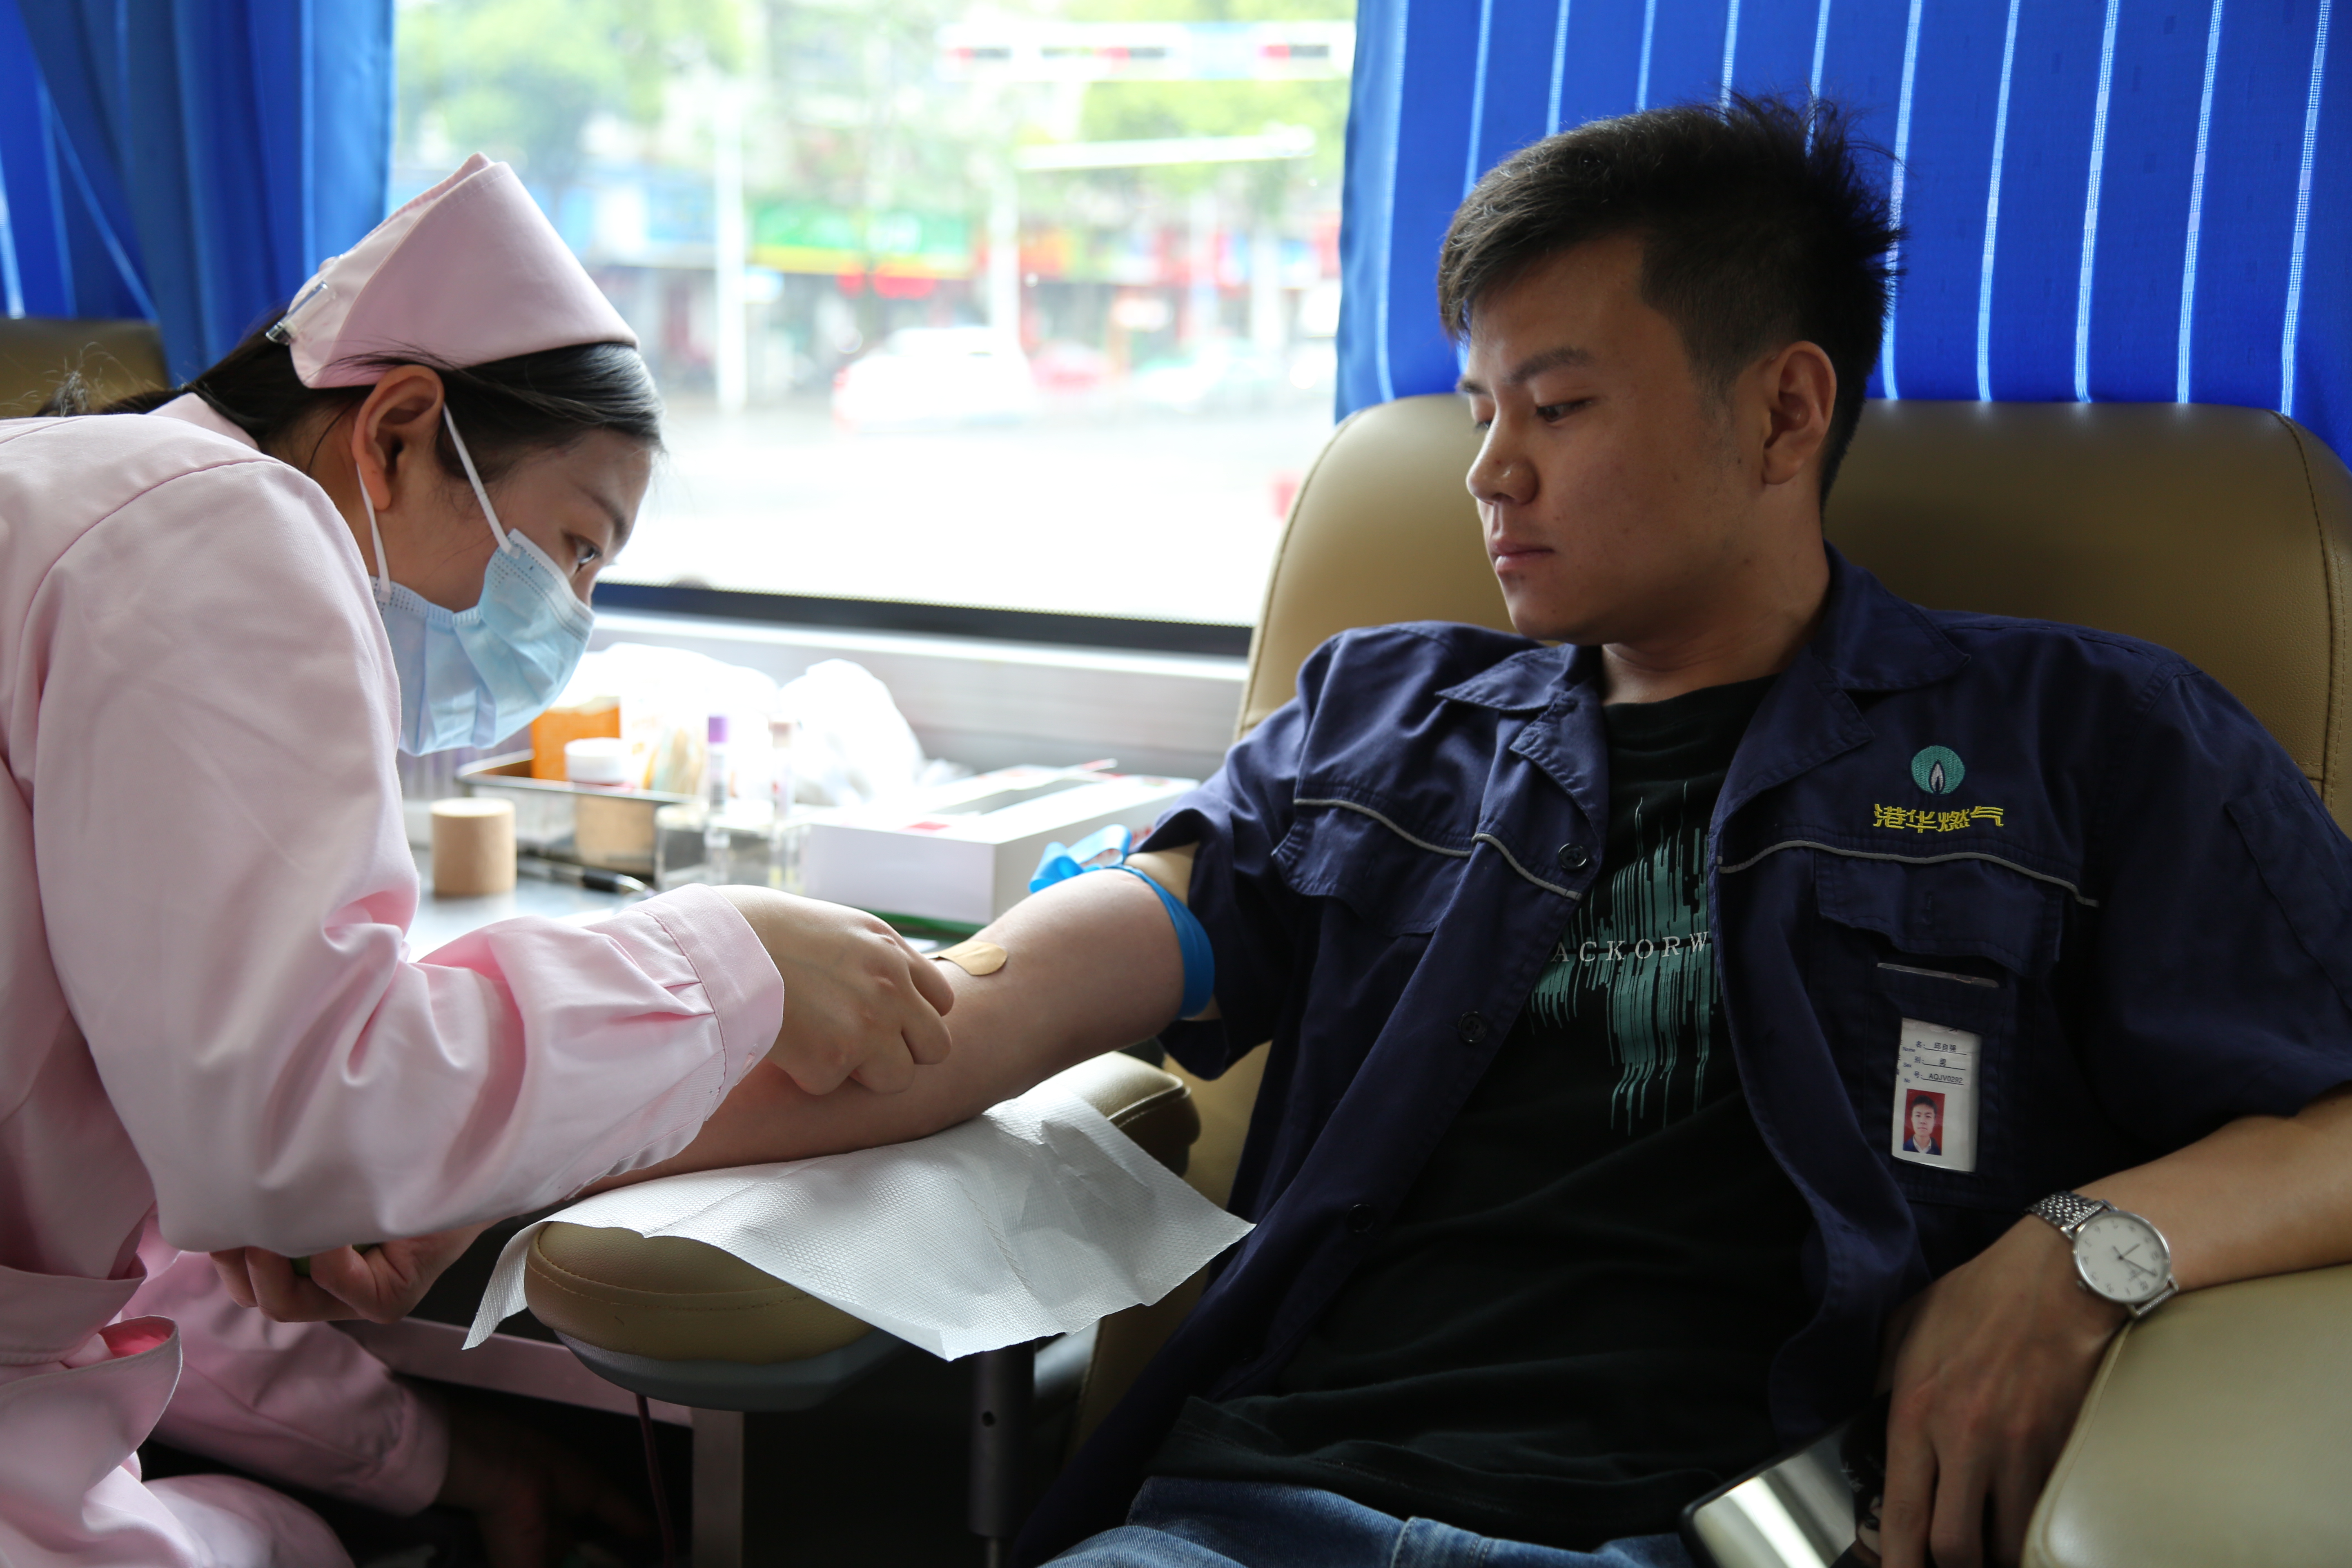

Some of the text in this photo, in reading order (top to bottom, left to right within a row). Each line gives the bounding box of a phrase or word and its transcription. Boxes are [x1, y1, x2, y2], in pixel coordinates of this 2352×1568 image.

[1873, 804, 2004, 833] 港华燃气
[1929, 1074, 1963, 1083] AQJV0292
